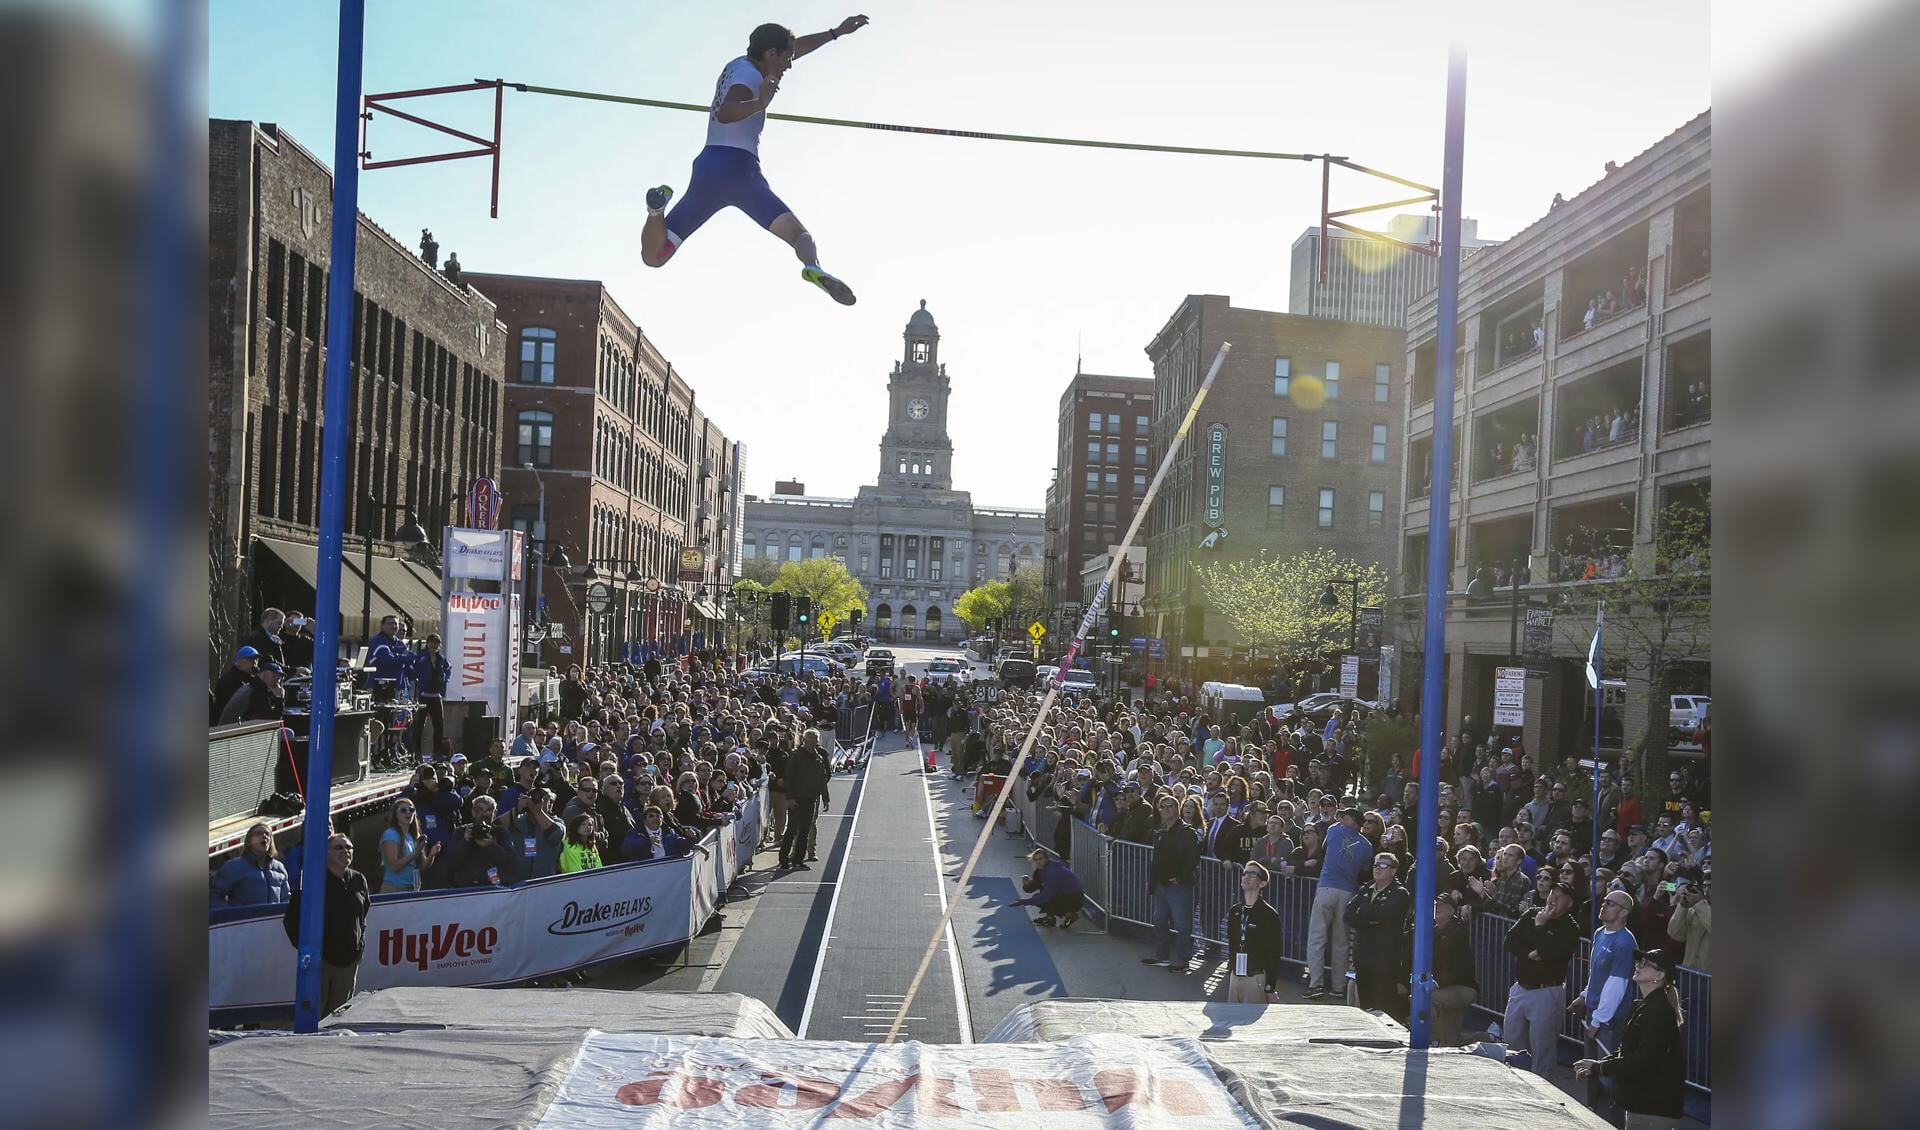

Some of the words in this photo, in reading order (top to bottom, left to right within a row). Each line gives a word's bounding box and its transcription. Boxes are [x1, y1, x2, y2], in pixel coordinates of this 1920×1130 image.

[1210, 431, 1222, 478] BREW
[1209, 485, 1220, 519] PUB
[451, 594, 500, 613] HyVee
[463, 619, 486, 686] VAULT
[511, 623, 519, 686] VAULT
[561, 900, 612, 929] Drake
[612, 896, 652, 918] RELAYS
[379, 922, 498, 972] HyVee
[436, 960, 468, 969] EMPLOYEE
[470, 957, 493, 966] OWNED
